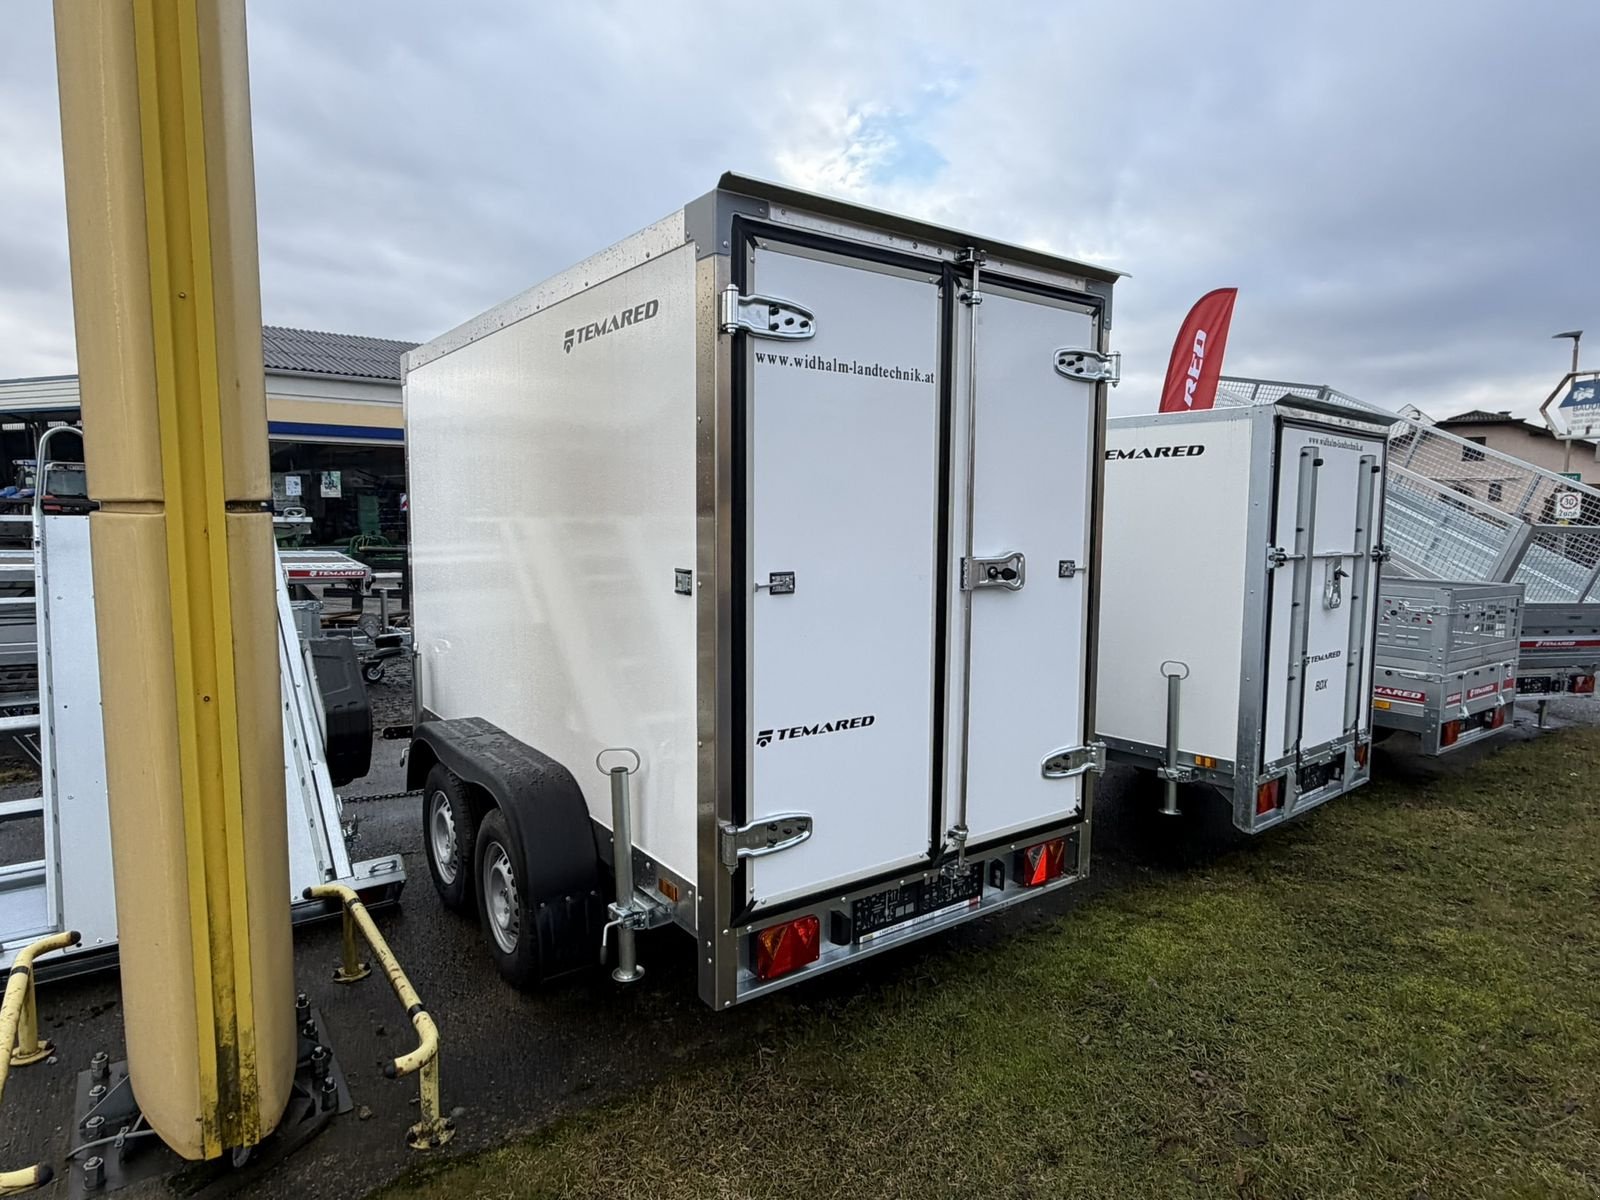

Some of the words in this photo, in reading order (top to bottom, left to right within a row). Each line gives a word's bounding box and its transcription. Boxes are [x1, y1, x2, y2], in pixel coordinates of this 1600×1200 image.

[576, 299, 659, 344] TEMARED
[755, 352, 935, 384] www.widhalm-landtechnik.at
[1183, 329, 1207, 408] RED
[1104, 445, 1205, 460] EMARED
[1563, 497, 1575, 506] 30
[1310, 650, 1341, 663] TEMARED
[777, 715, 875, 741] TEMARED
